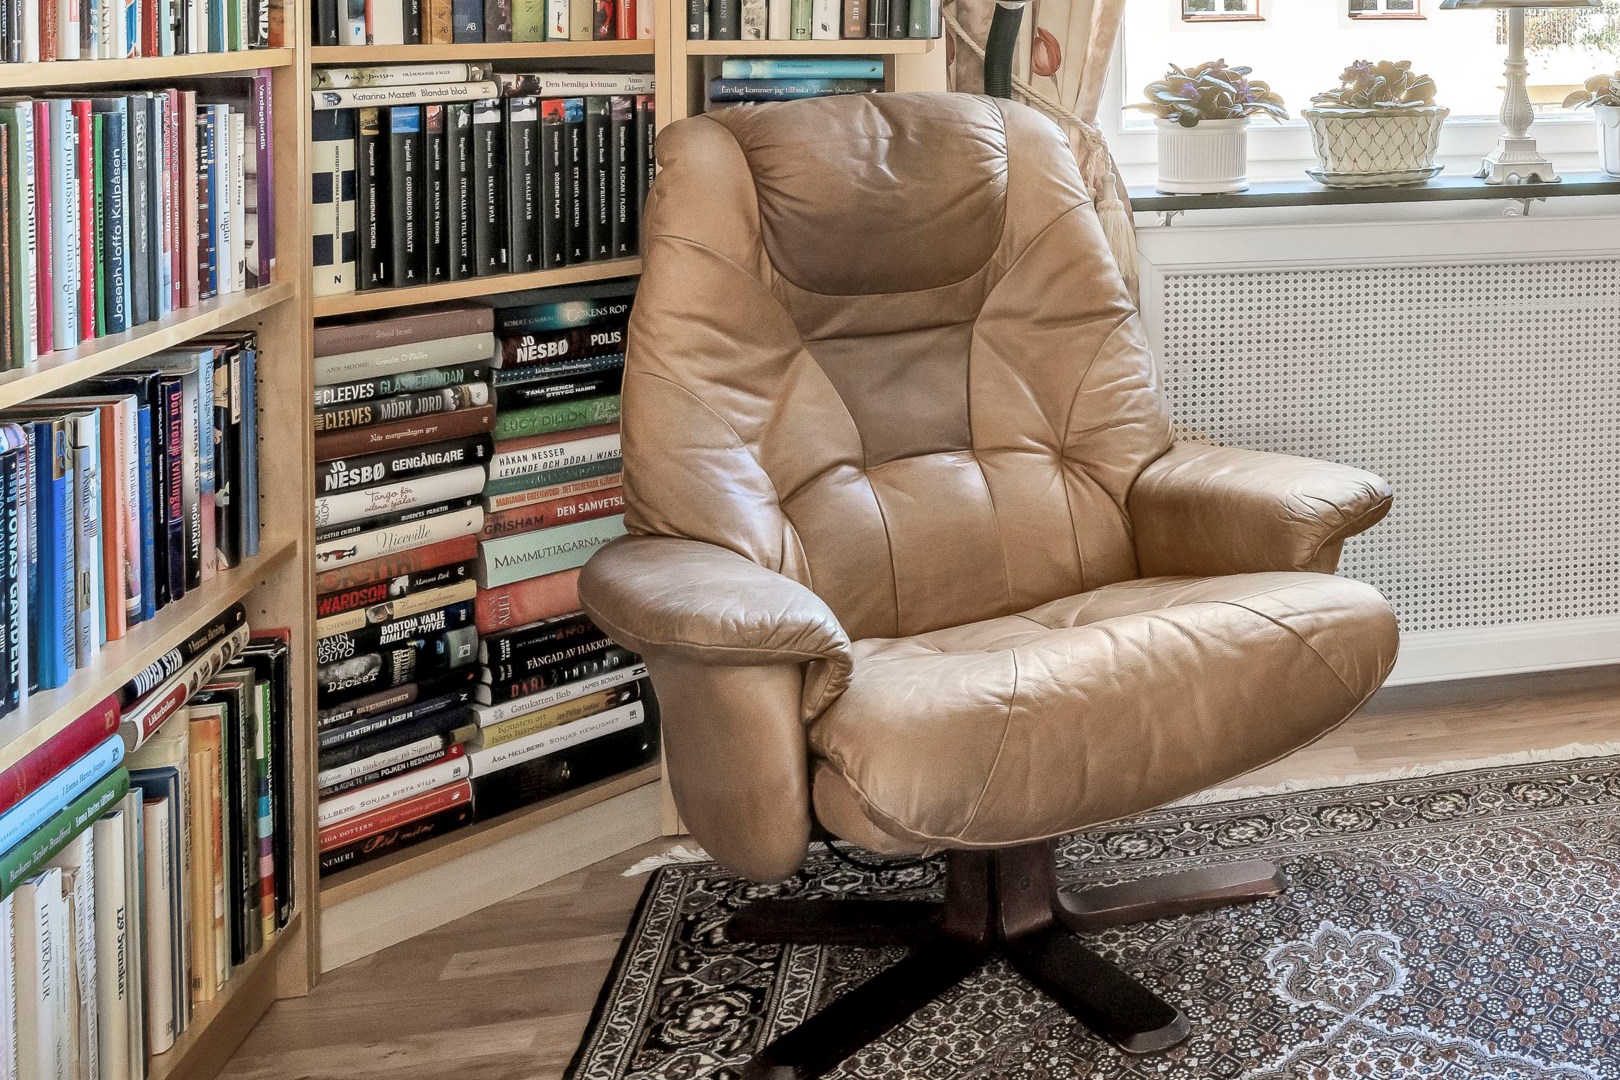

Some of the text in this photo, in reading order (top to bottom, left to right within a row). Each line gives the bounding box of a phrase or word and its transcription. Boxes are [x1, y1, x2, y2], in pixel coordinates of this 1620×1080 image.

[352, 87, 468, 101] Katarina Mazetti Blandat blod
[545, 80, 560, 88] Den
[562, 80, 588, 89] hemliga
[258, 85, 266, 150] Vardagsjuridik
[110, 148, 122, 220] Kulpåsen
[520, 336, 534, 346] JO
[591, 332, 621, 346] POLIS
[516, 340, 568, 363] NESBØ
[323, 382, 374, 403] CLEEVES
[325, 407, 371, 429] CLEEVES
[381, 395, 442, 419] MÖRK JORD
[504, 411, 587, 432] LUCY DILLON
[330, 460, 346, 473] JO
[392, 449, 464, 472] GENGÅNGARE
[500, 448, 565, 465] HÅKAN NESSER
[500, 455, 587, 477] LEVANDE OCH DÖDA
[325, 463, 385, 491] NESBØ
[557, 506, 576, 517] DEN
[484, 516, 544, 535] GRISHAM
[9, 505, 18, 575] JONAS
[381, 610, 445, 636] BORTOM VARJE
[135, 648, 183, 697] VIVECA STEN
[327, 672, 378, 692] Dicker
[116, 908, 125, 1000] 129 Svenskar.
